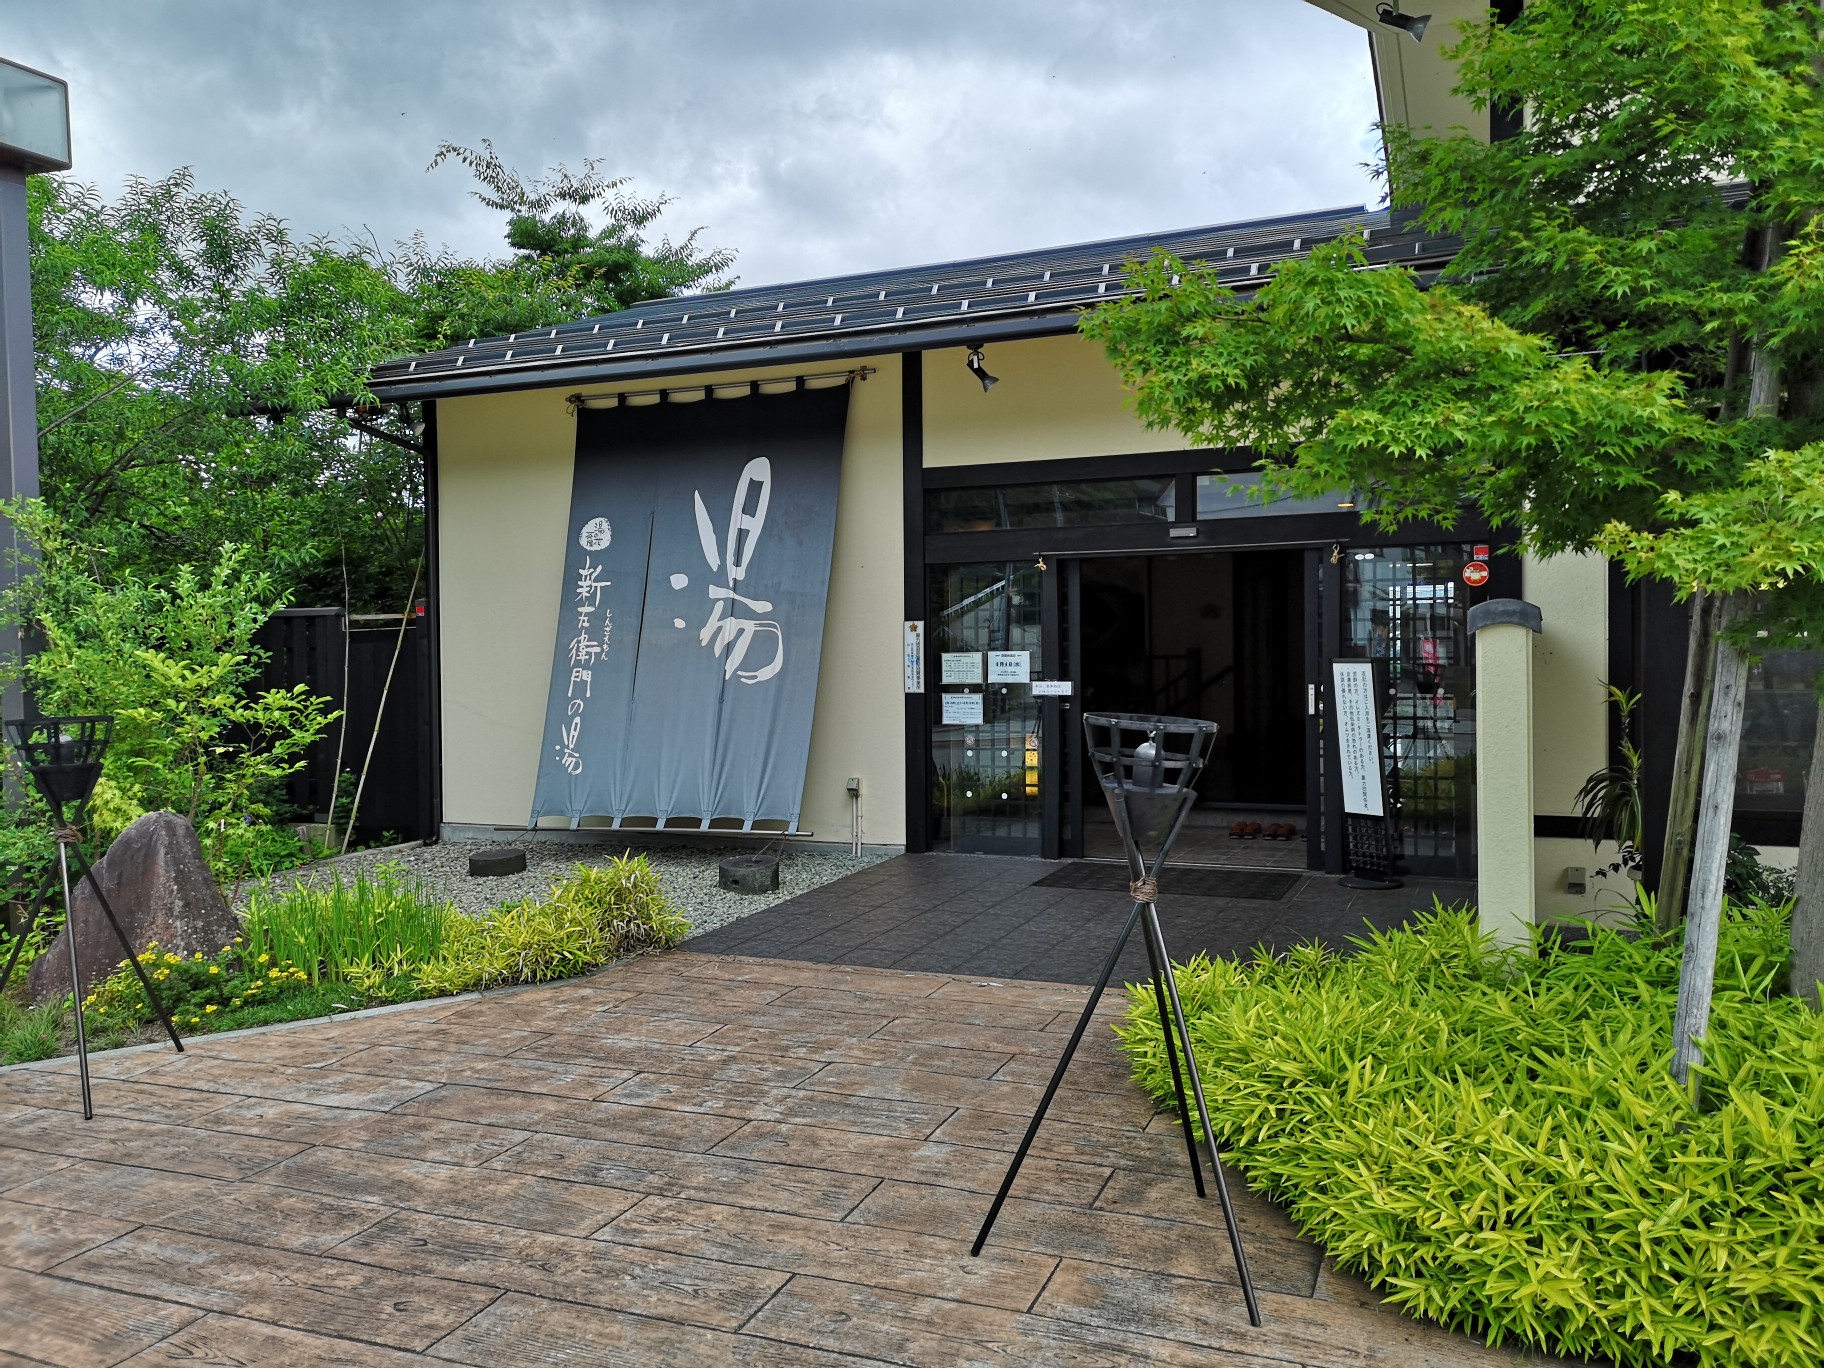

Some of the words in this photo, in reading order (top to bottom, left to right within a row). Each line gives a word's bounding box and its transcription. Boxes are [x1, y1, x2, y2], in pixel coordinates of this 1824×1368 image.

[555, 555, 612, 775] 新左衛門の湯
[600, 608, 613, 660] しんざえもん
[670, 457, 784, 684] 湯
